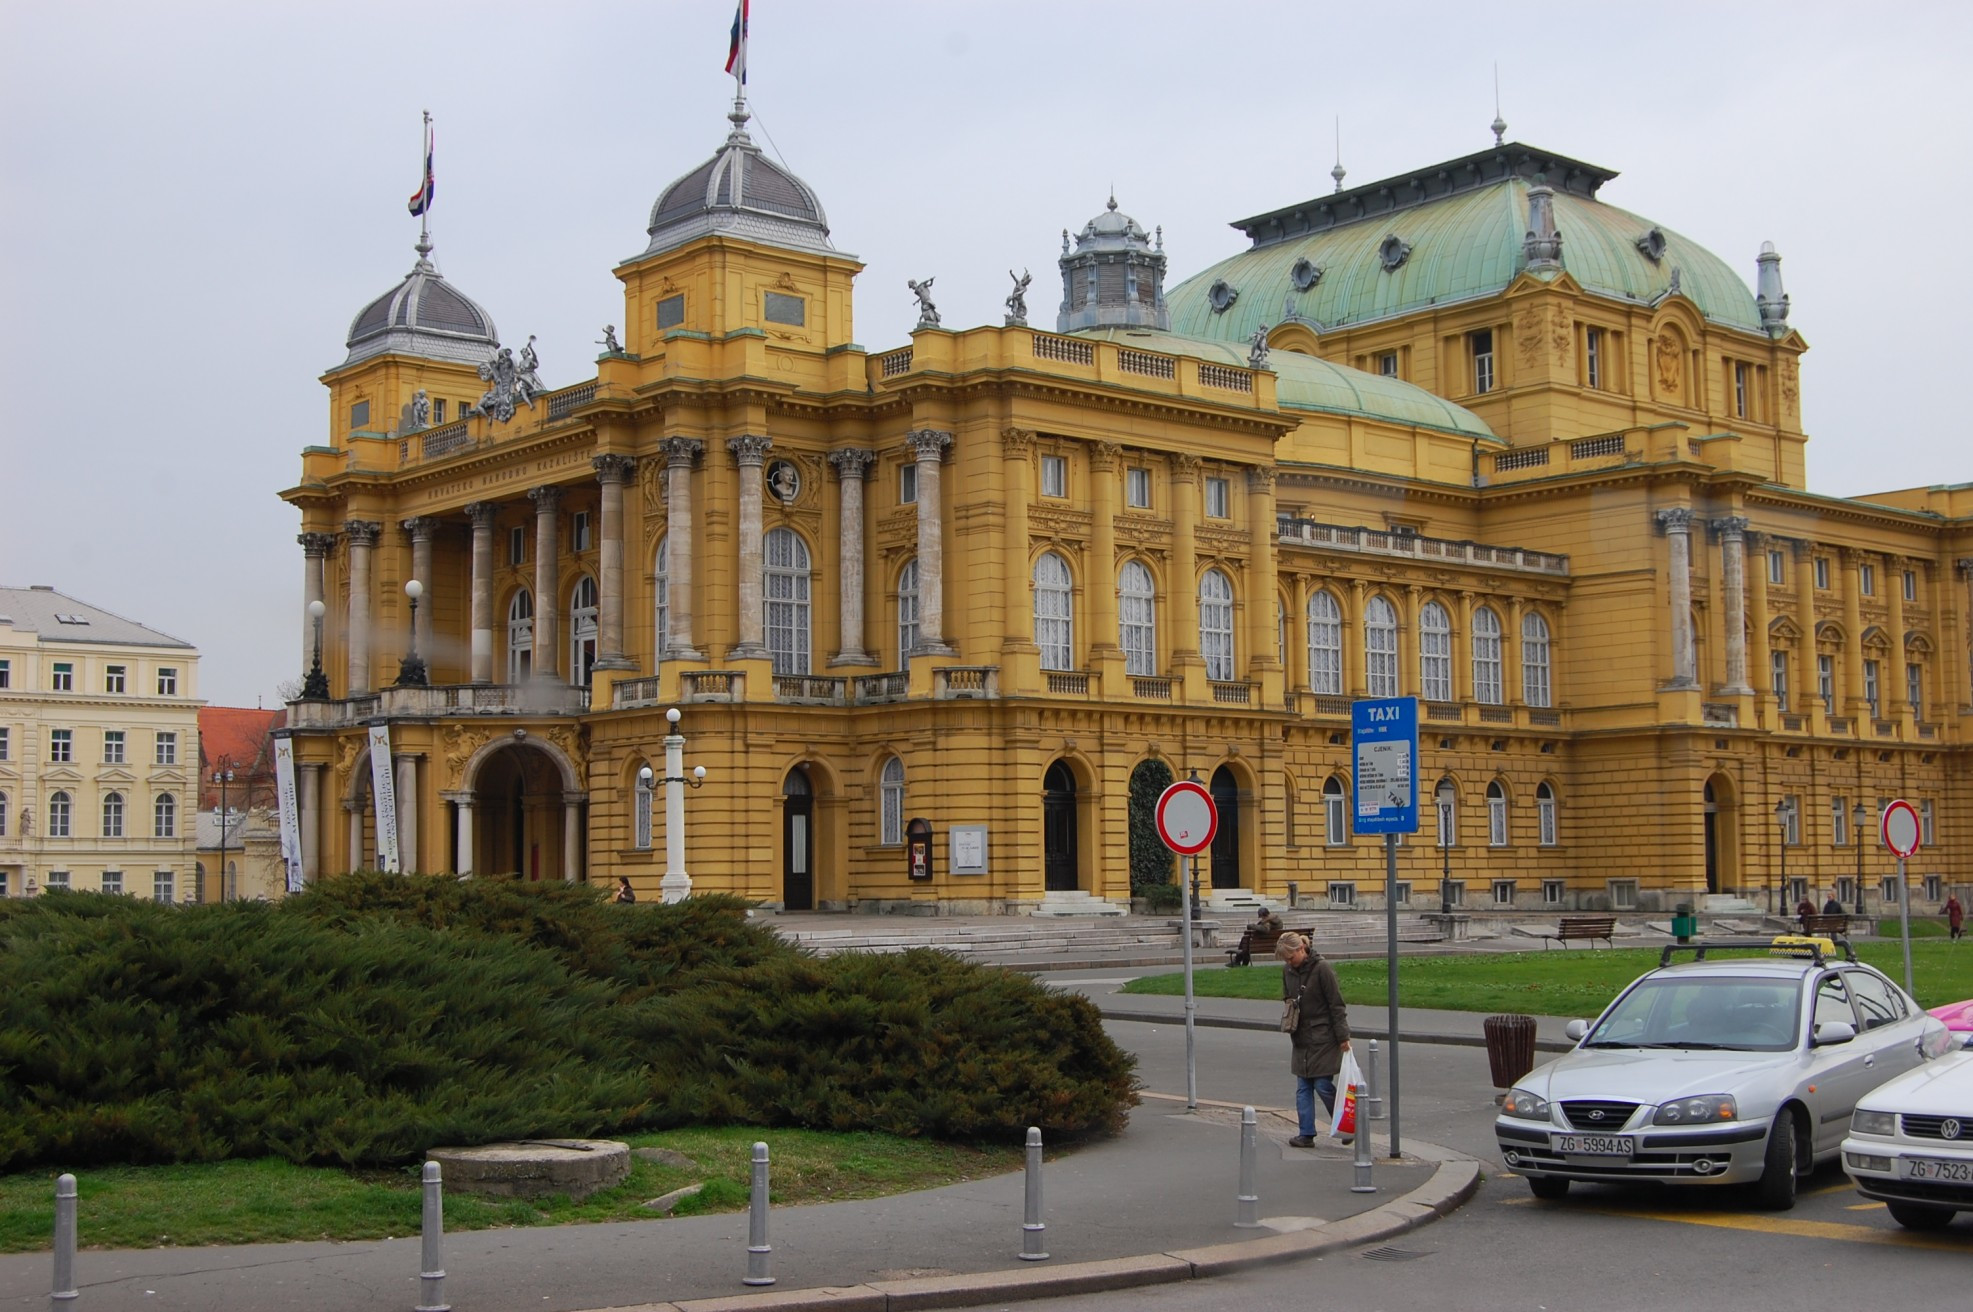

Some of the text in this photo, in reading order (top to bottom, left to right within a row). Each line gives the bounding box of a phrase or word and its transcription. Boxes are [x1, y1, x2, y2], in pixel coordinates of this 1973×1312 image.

[1367, 706, 1400, 721] TAXI
[384, 768, 394, 812] SCHICCHI
[288, 779, 297, 834] MACABRE
[1560, 1137, 1575, 1151] ZG
[1909, 1160, 1925, 1177] ZG
